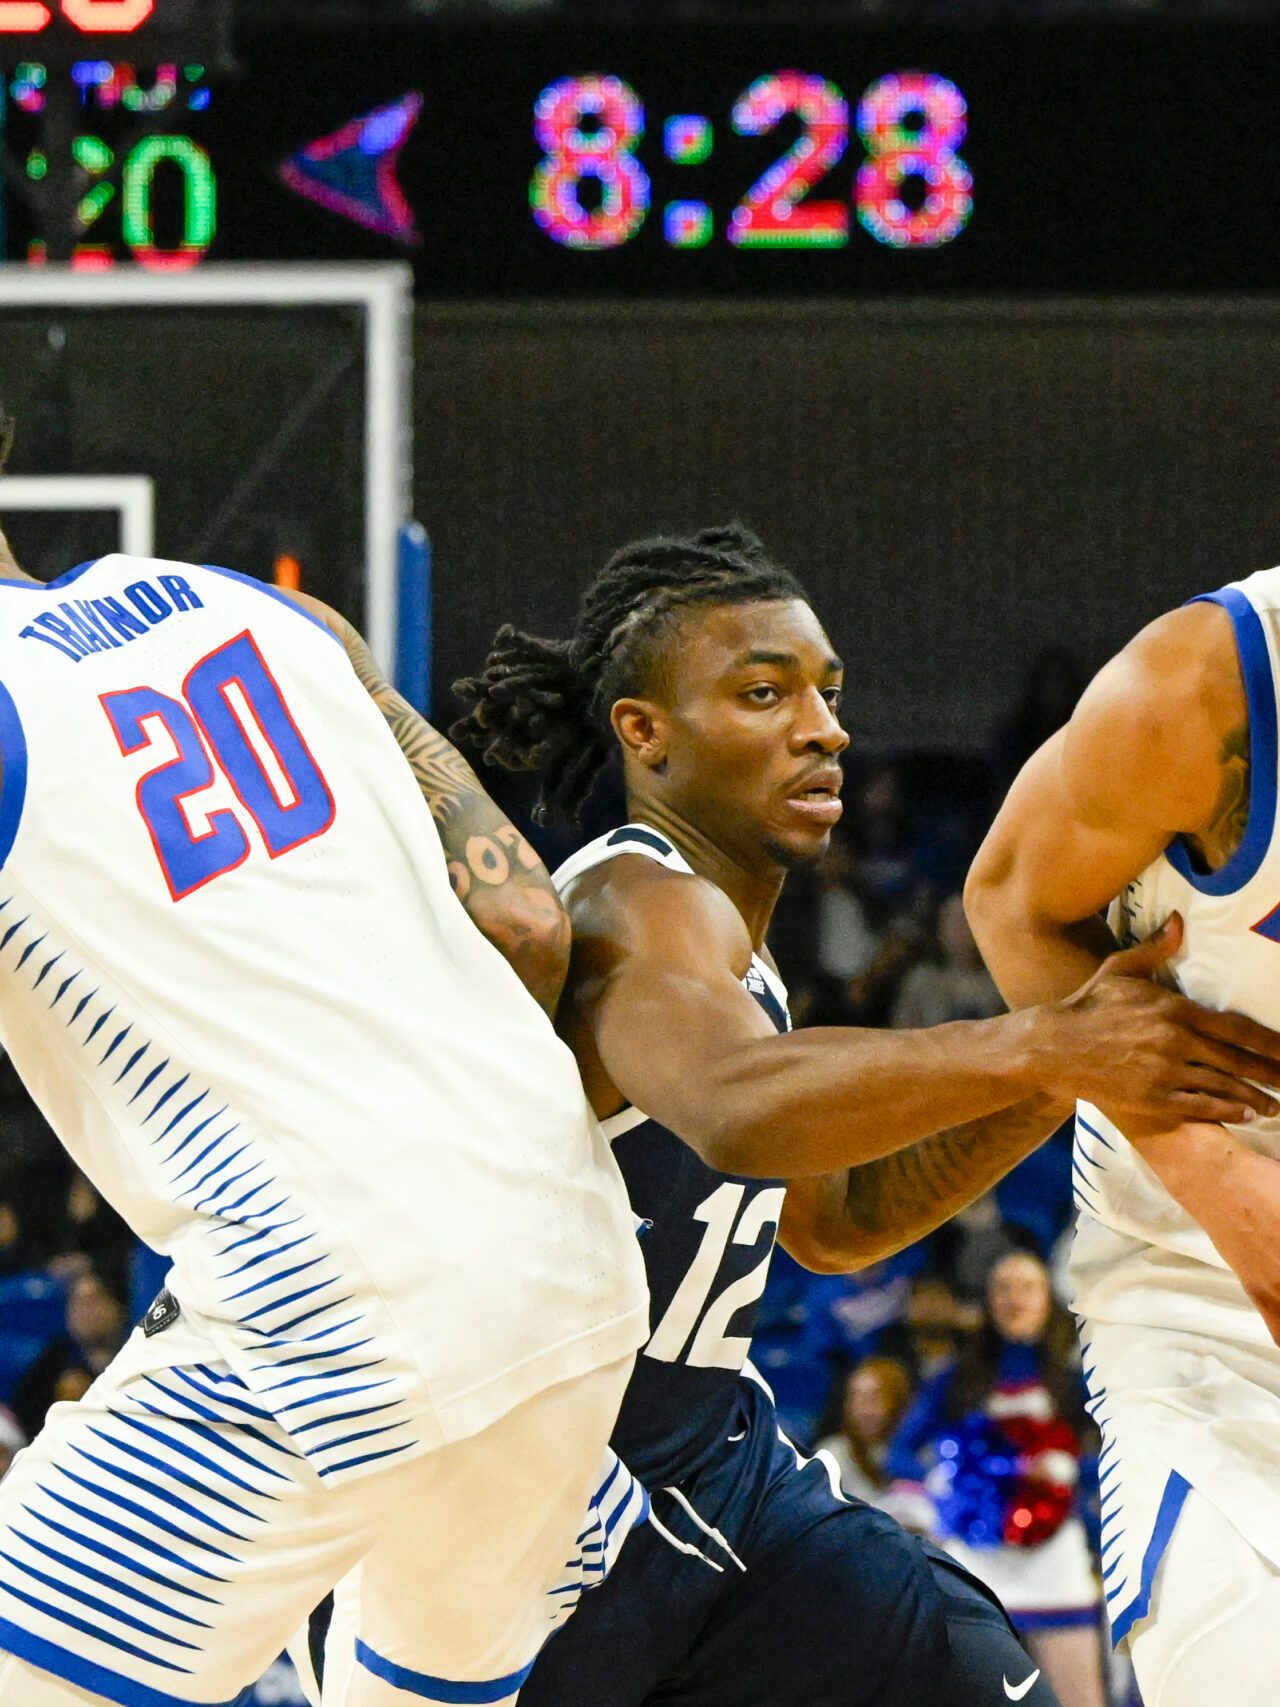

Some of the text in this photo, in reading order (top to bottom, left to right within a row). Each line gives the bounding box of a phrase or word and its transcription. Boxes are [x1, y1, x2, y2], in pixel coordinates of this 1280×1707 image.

[529, 69, 974, 250] 8:28
[18, 575, 205, 663] TRAYNOR
[97, 628, 337, 903] 20
[643, 1181, 788, 1371] 12
